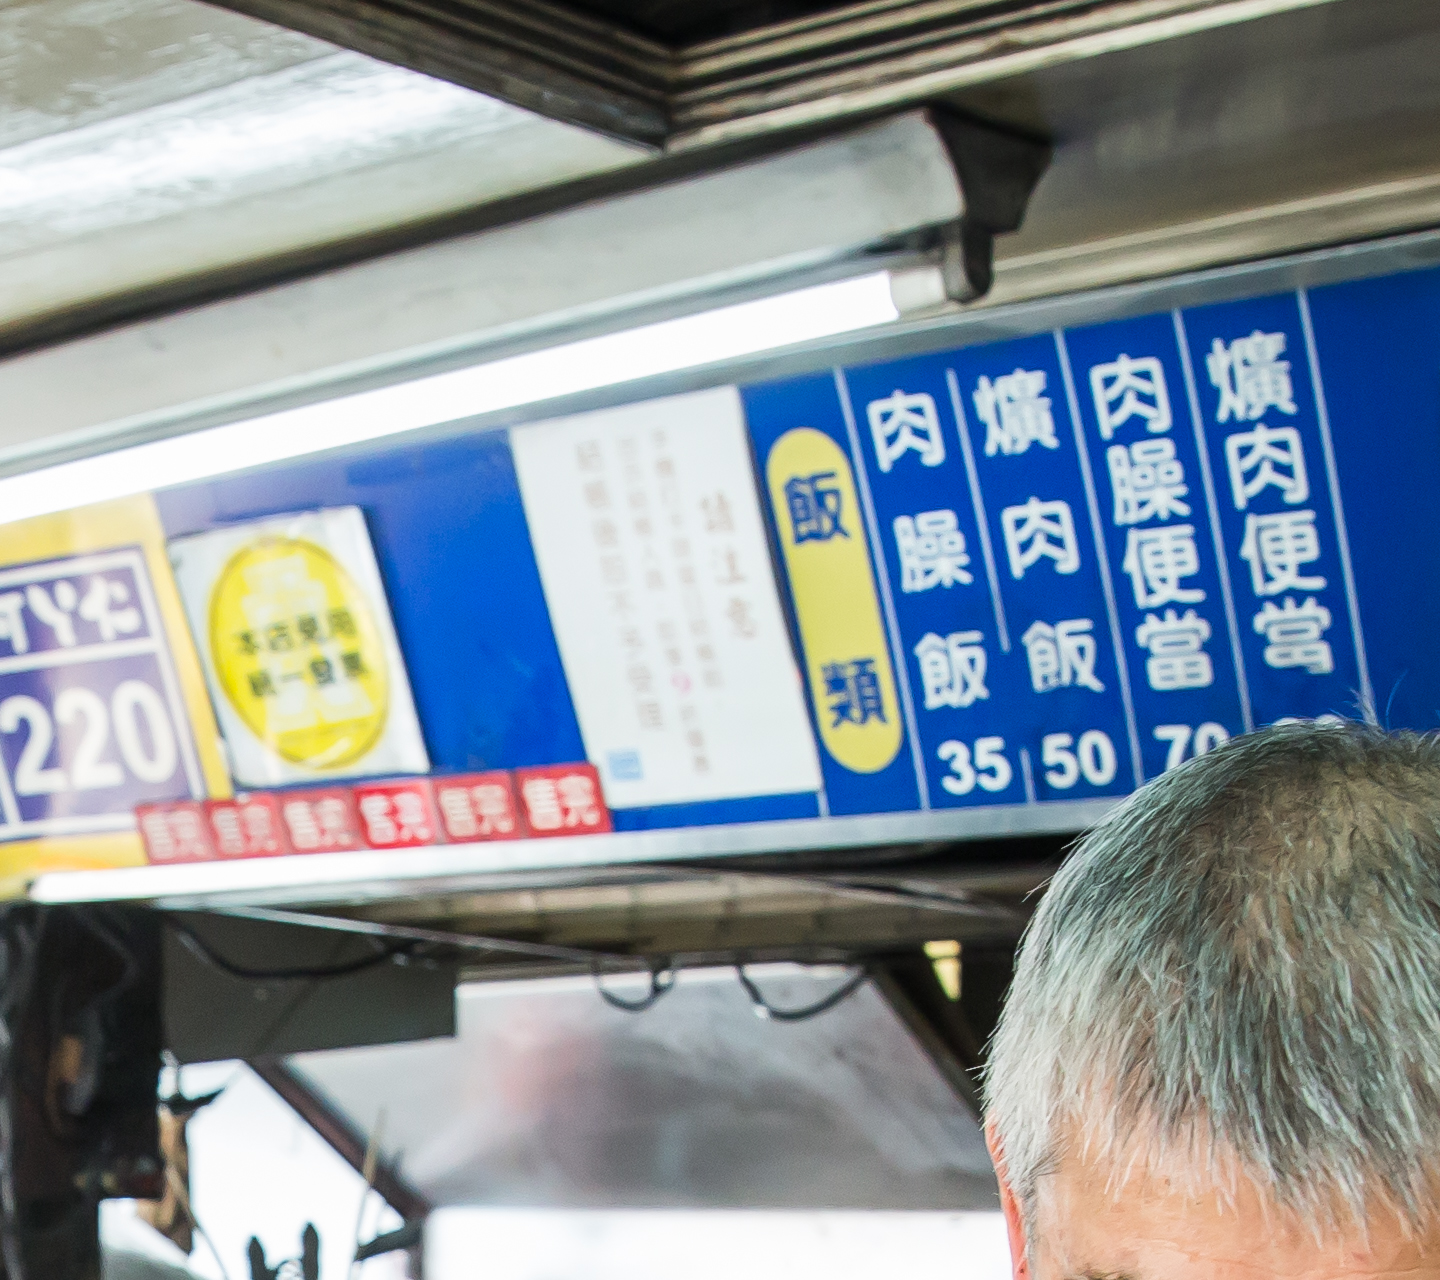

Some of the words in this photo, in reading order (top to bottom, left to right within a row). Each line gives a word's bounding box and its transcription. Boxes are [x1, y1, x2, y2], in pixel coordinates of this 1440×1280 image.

[782, 471, 889, 730] 飯類
[866, 389, 989, 711] 肉臊飯
[973, 367, 1105, 695] 爌肉飯
[1090, 354, 1215, 692] 肉臊便當
[1205, 329, 1334, 677] 爌肉便當
[936, 735, 1014, 796] 35
[1040, 730, 1116, 790] 50
